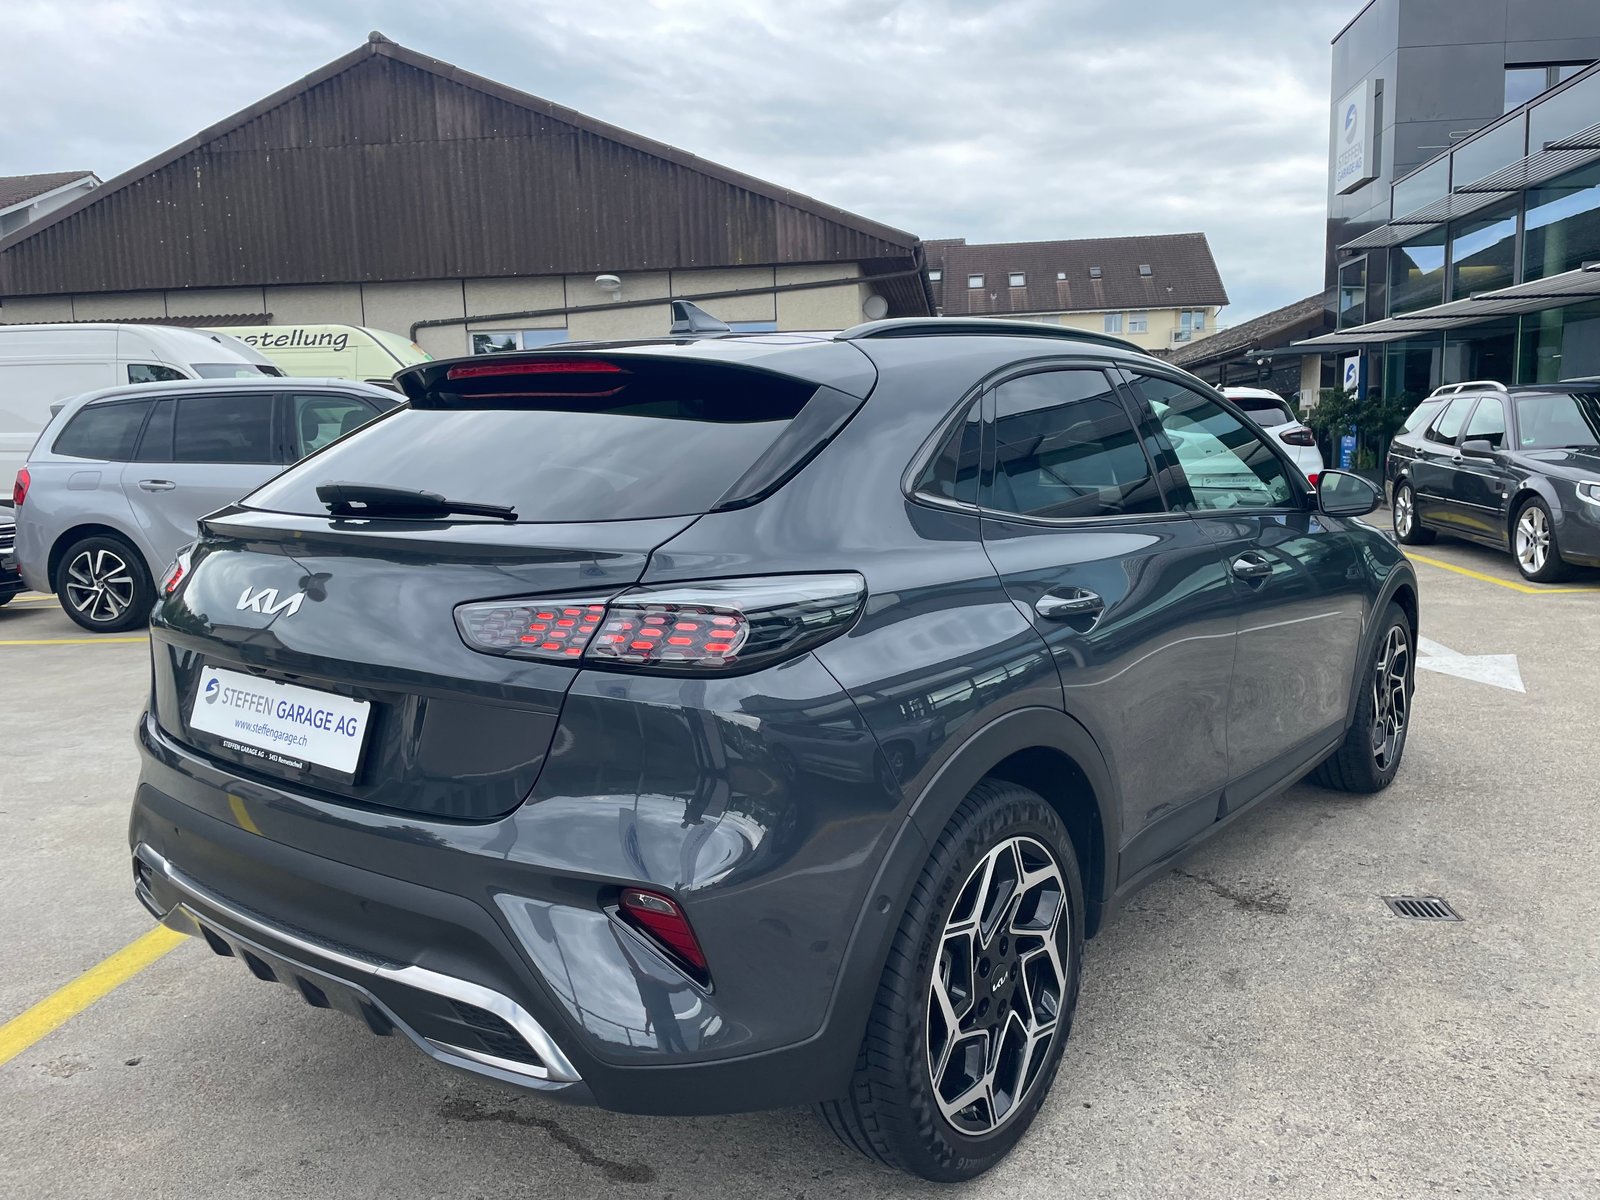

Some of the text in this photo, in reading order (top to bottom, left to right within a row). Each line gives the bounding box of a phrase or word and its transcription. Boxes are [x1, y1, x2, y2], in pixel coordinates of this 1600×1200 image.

[235, 329, 349, 352] stellung
[236, 586, 306, 617] KIA
[222, 687, 358, 737] STEFFEN GARAGE AG
[234, 718, 308, 747] www.steffengarage.ch
[223, 740, 241, 751] STEFFEN
[240, 745, 258, 756] GARAGE
[258, 750, 265, 758] AG
